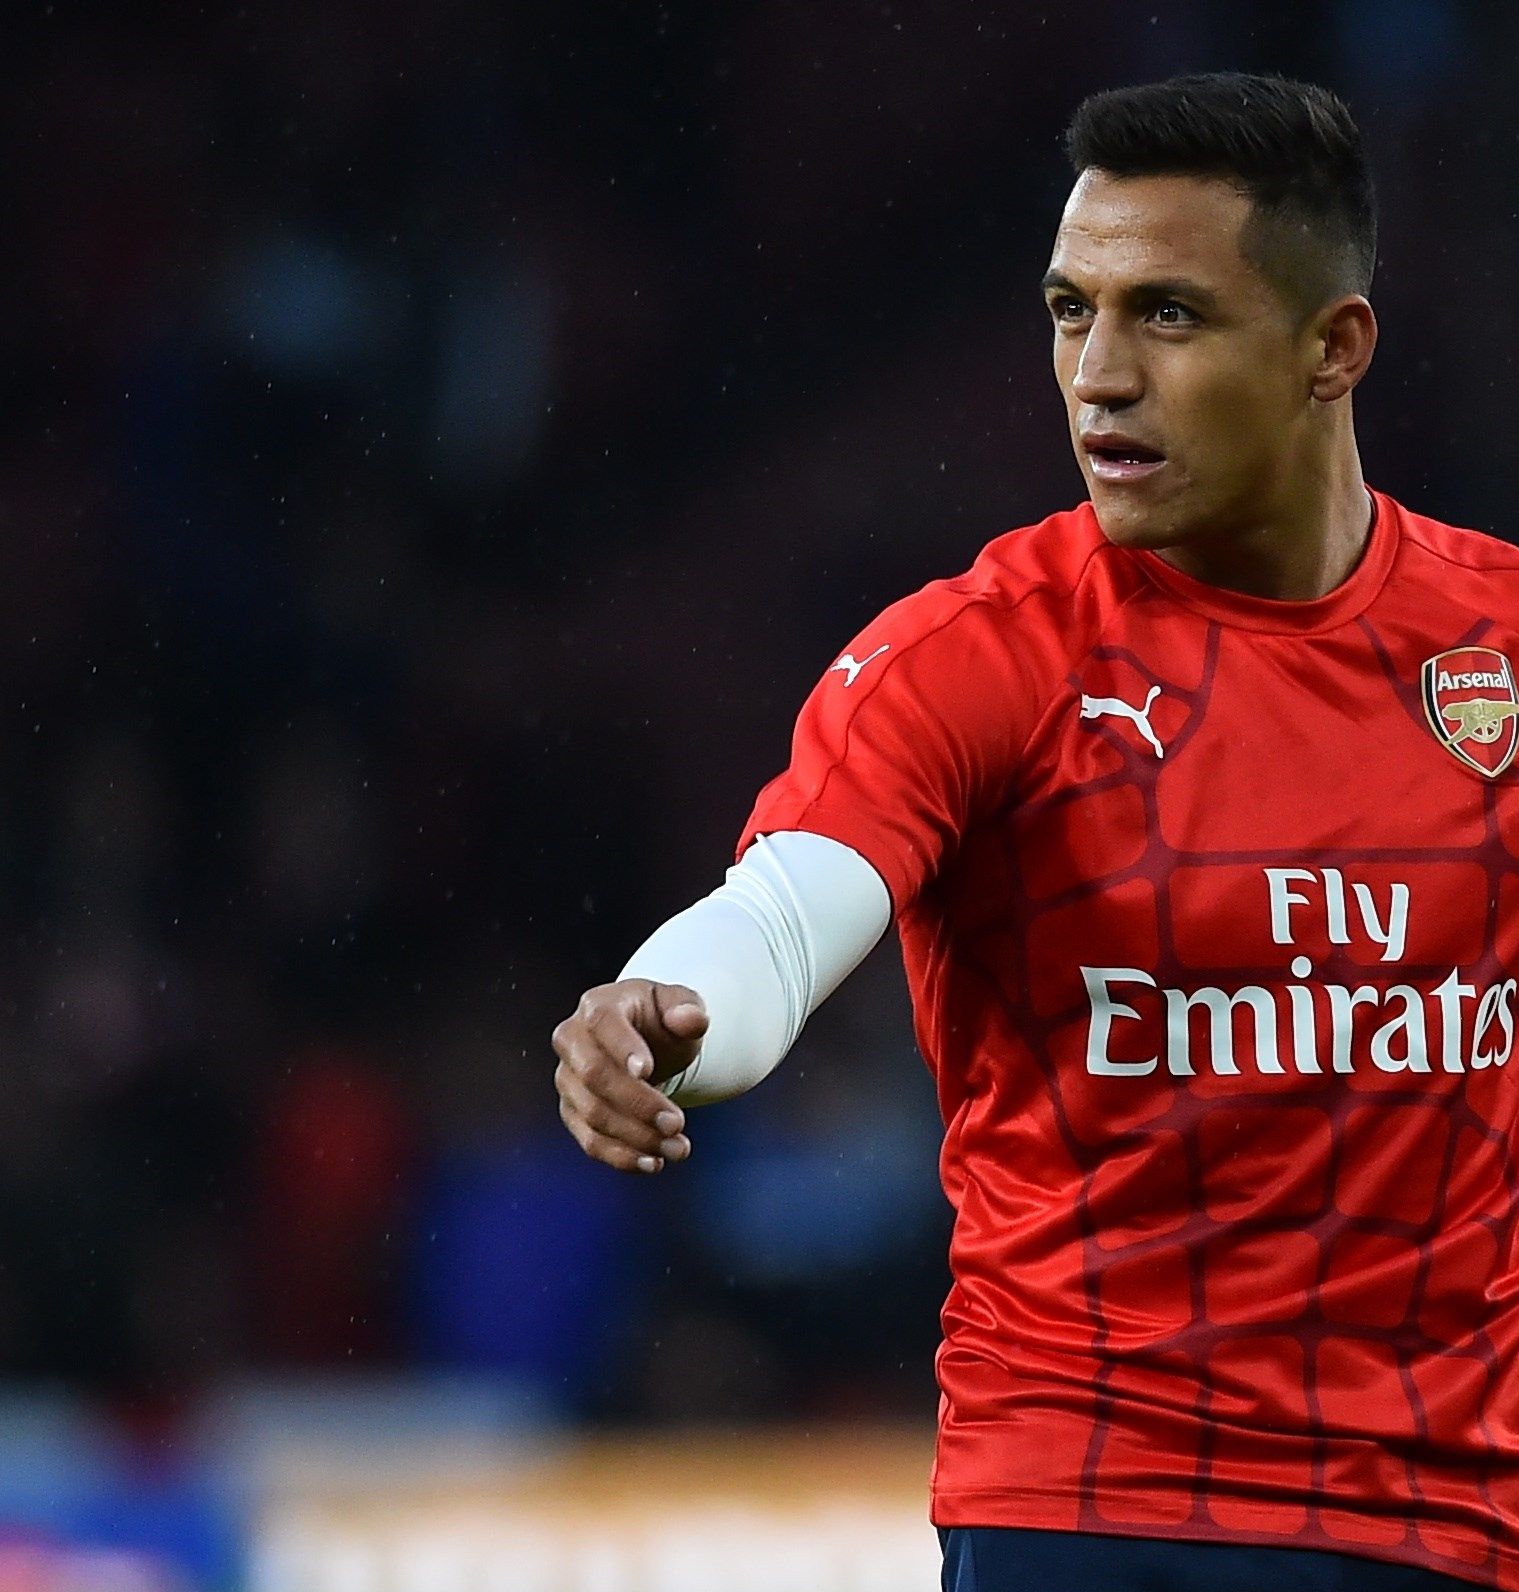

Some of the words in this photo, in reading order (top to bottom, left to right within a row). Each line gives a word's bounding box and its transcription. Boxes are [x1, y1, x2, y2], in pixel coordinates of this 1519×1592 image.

[1437, 669, 1509, 692] Arsenal
[1262, 867, 1410, 962] Fly
[1079, 955, 1518, 1076] Emirates
